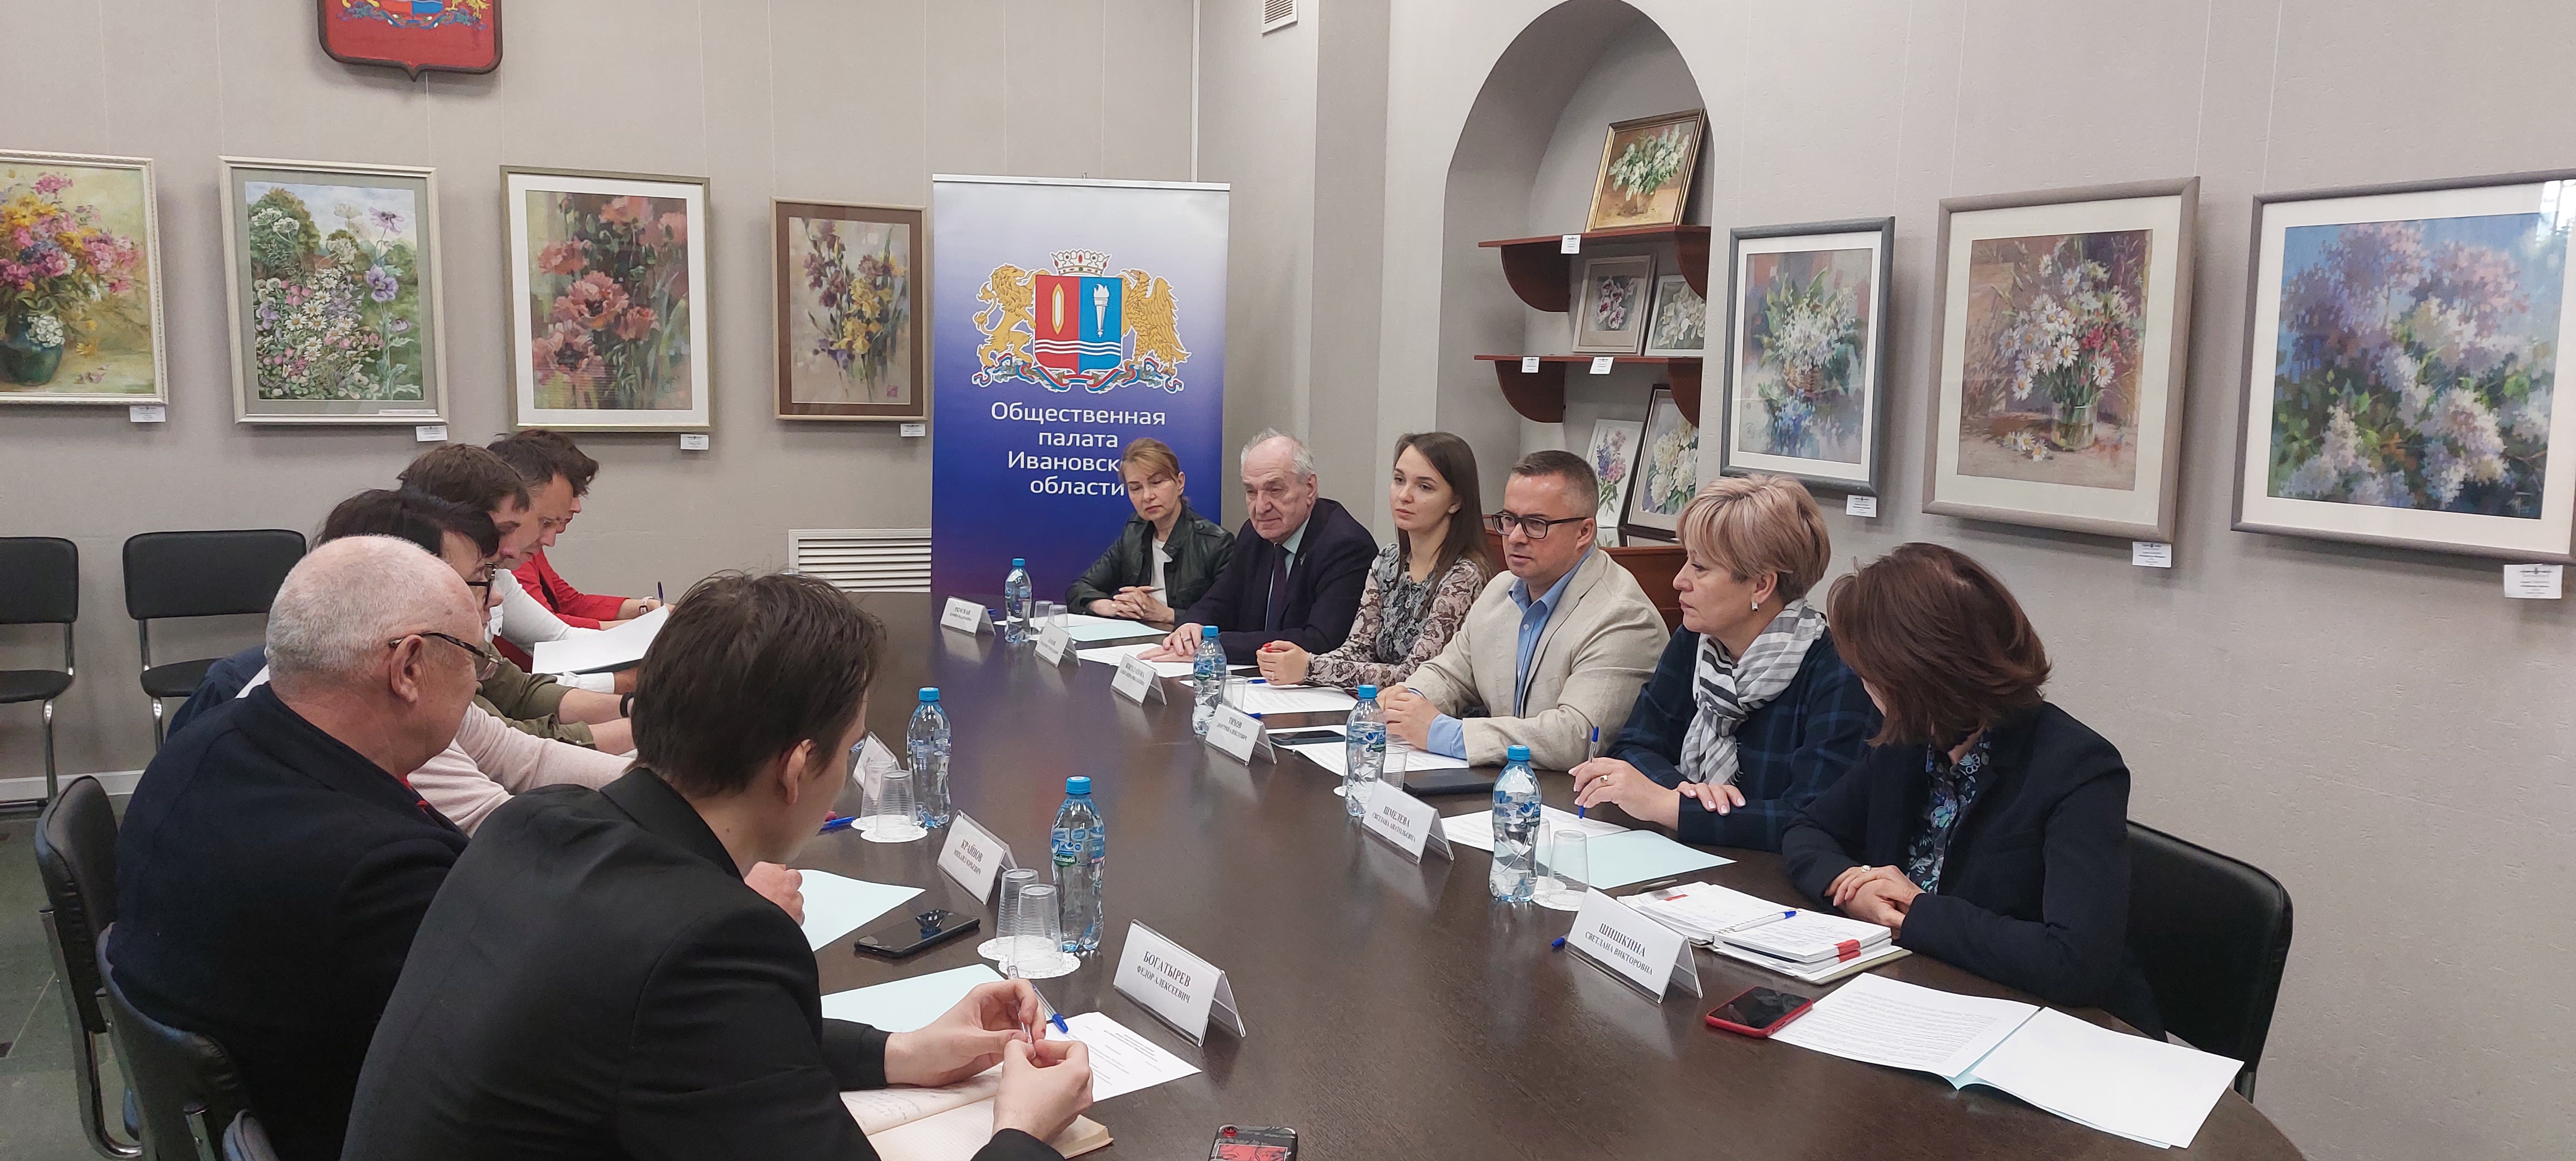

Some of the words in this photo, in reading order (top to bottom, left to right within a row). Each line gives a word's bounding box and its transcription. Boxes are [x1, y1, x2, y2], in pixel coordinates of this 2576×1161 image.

[991, 401, 1166, 425] Общественная
[1038, 432, 1119, 448] палата
[1008, 450, 1121, 472] Ивановск
[1030, 475, 1125, 496] области
[1383, 806, 1410, 828] ШМЕЛЕВА
[960, 839, 983, 862] КРАЙНОВ
[1598, 923, 1646, 958] ШИШКИНА
[1585, 931, 1613, 953] СВЕТЛАНА
[1613, 948, 1653, 975] ВИКТОРОВНА
[1143, 950, 1191, 987] БОГАТЫРЕВ
[1136, 965, 1155, 980] ФЕДОР
[1154, 976, 1191, 1004] АЛЕКСЕЕВИЧ
